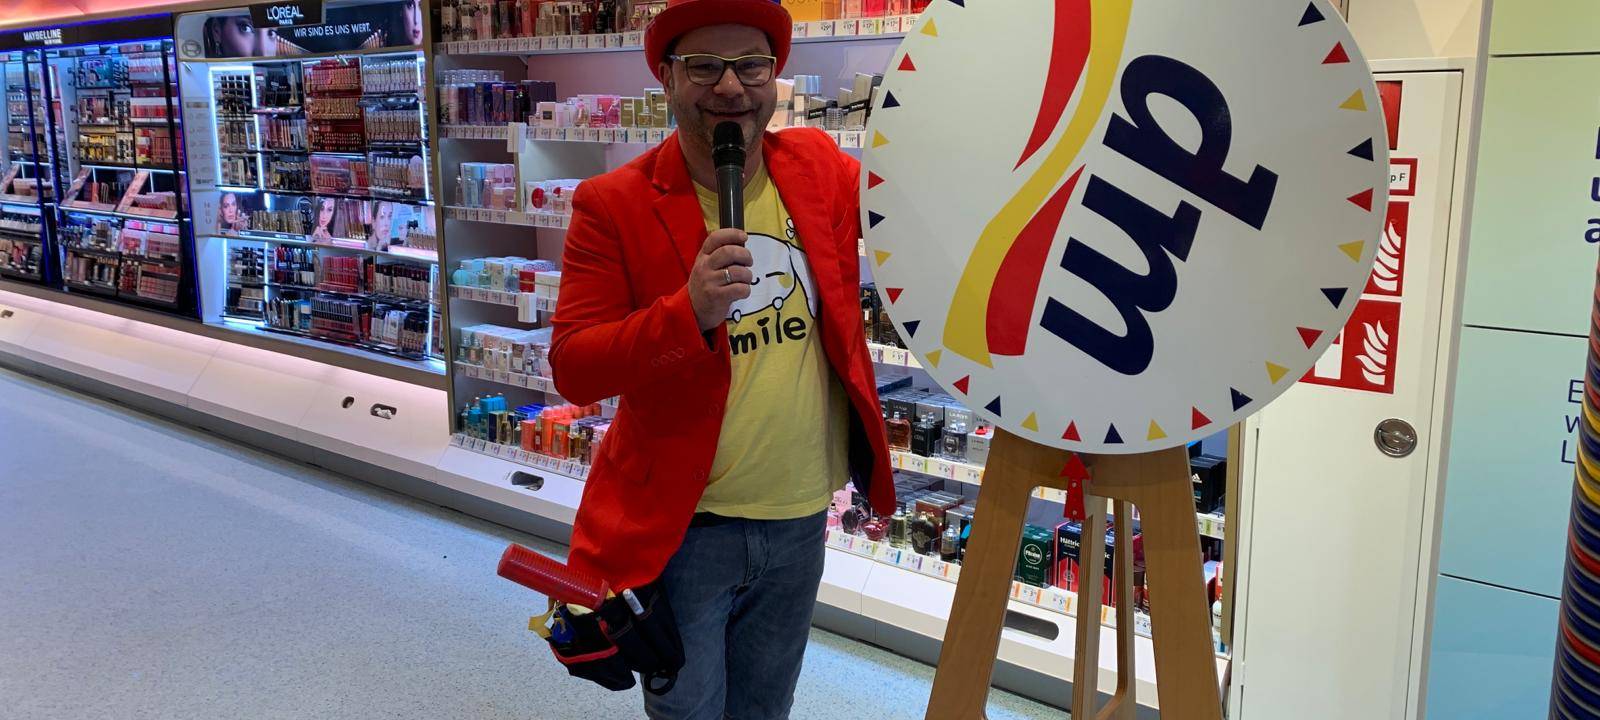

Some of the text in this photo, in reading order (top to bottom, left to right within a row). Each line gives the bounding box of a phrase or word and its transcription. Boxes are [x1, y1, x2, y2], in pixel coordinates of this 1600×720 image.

[23, 28, 62, 42] MAYBELLINE
[294, 22, 371, 38] WIR SIND ES UNS WERT.
[1399, 172, 1406, 182] F
[729, 311, 806, 355] mile
